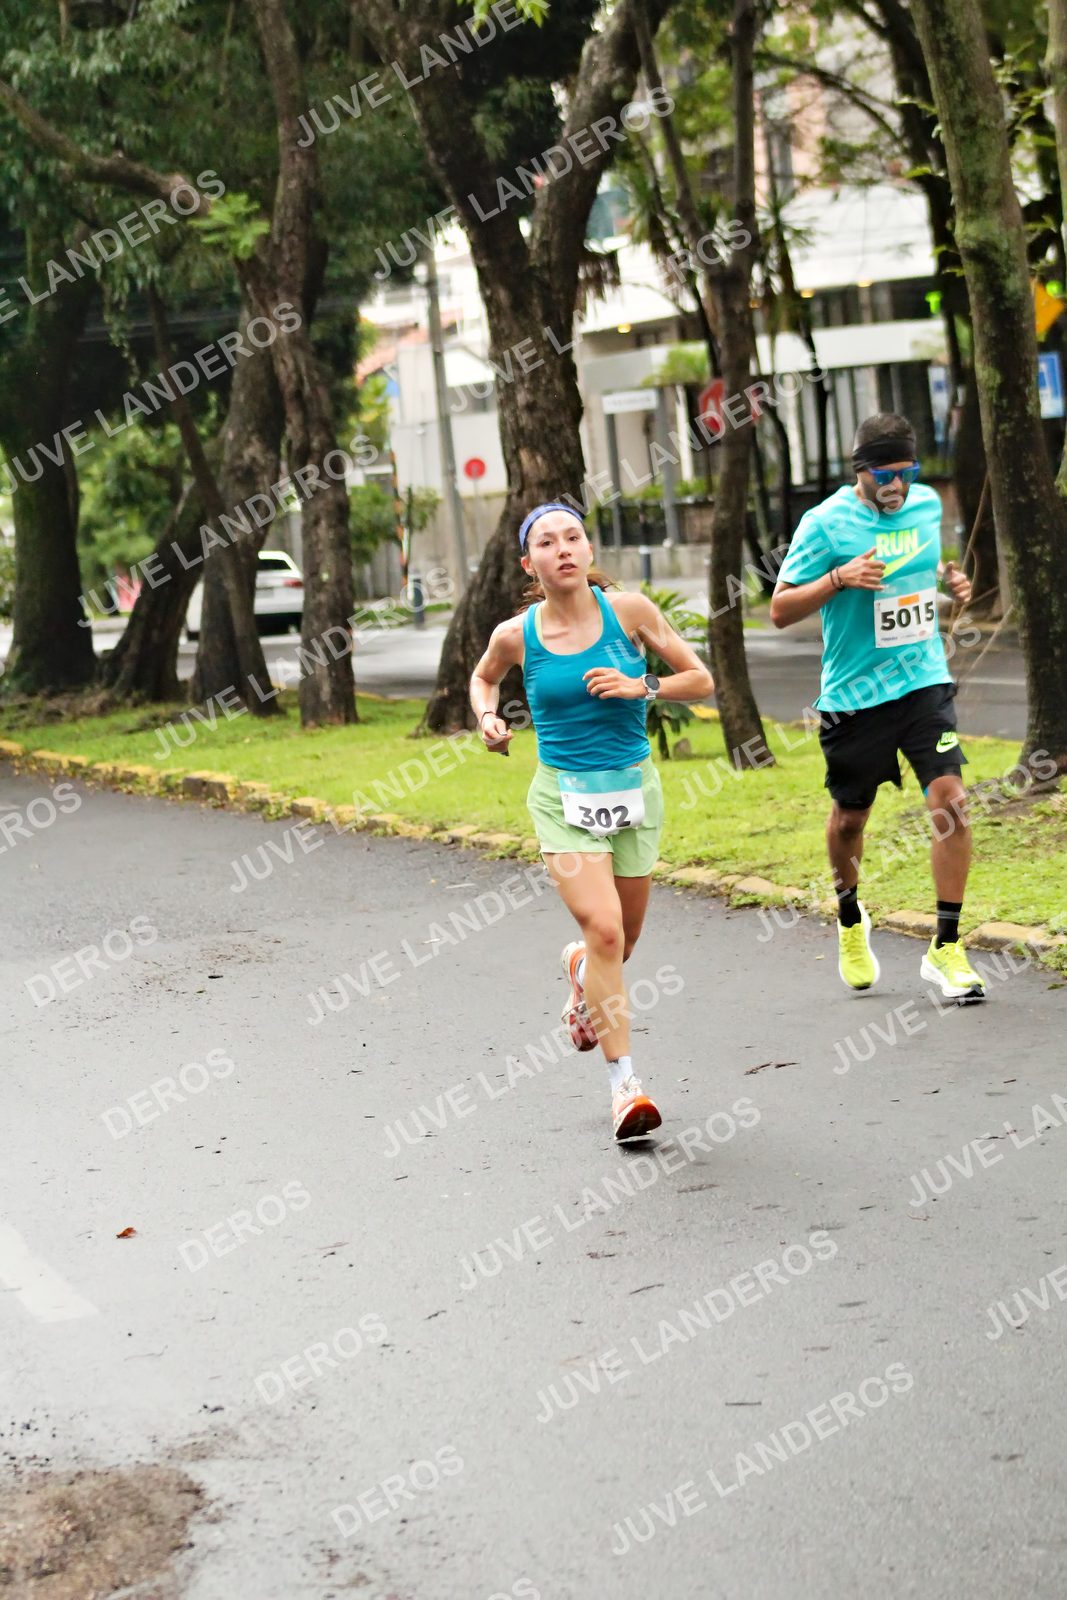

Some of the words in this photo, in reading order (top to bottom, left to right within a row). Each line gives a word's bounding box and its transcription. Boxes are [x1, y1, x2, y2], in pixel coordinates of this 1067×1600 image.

[876, 528, 918, 557] RUN
[880, 600, 934, 631] 5015
[578, 805, 631, 828] 302
